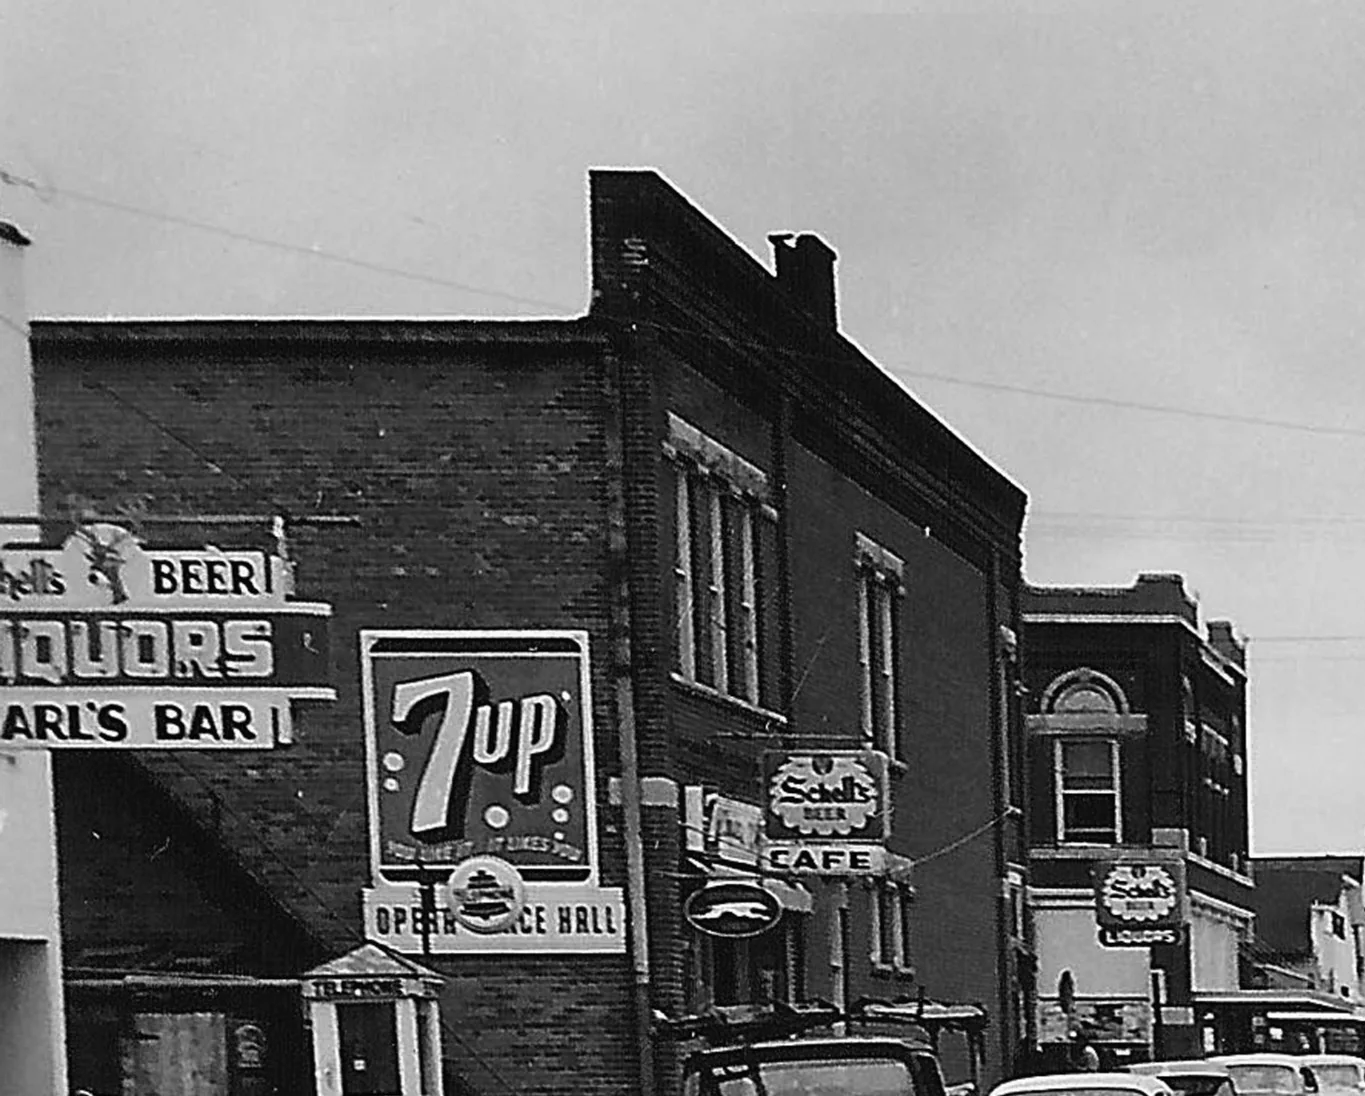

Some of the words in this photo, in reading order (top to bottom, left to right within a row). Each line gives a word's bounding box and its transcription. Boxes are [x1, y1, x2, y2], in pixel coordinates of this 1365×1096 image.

[153, 559, 259, 595] BEER
[155, 704, 256, 742] BAR
[803, 807, 847, 821] BEER
[770, 850, 871, 870] CAFE
[558, 906, 618, 935] HALL
[1105, 929, 1176, 943] LIQUORS
